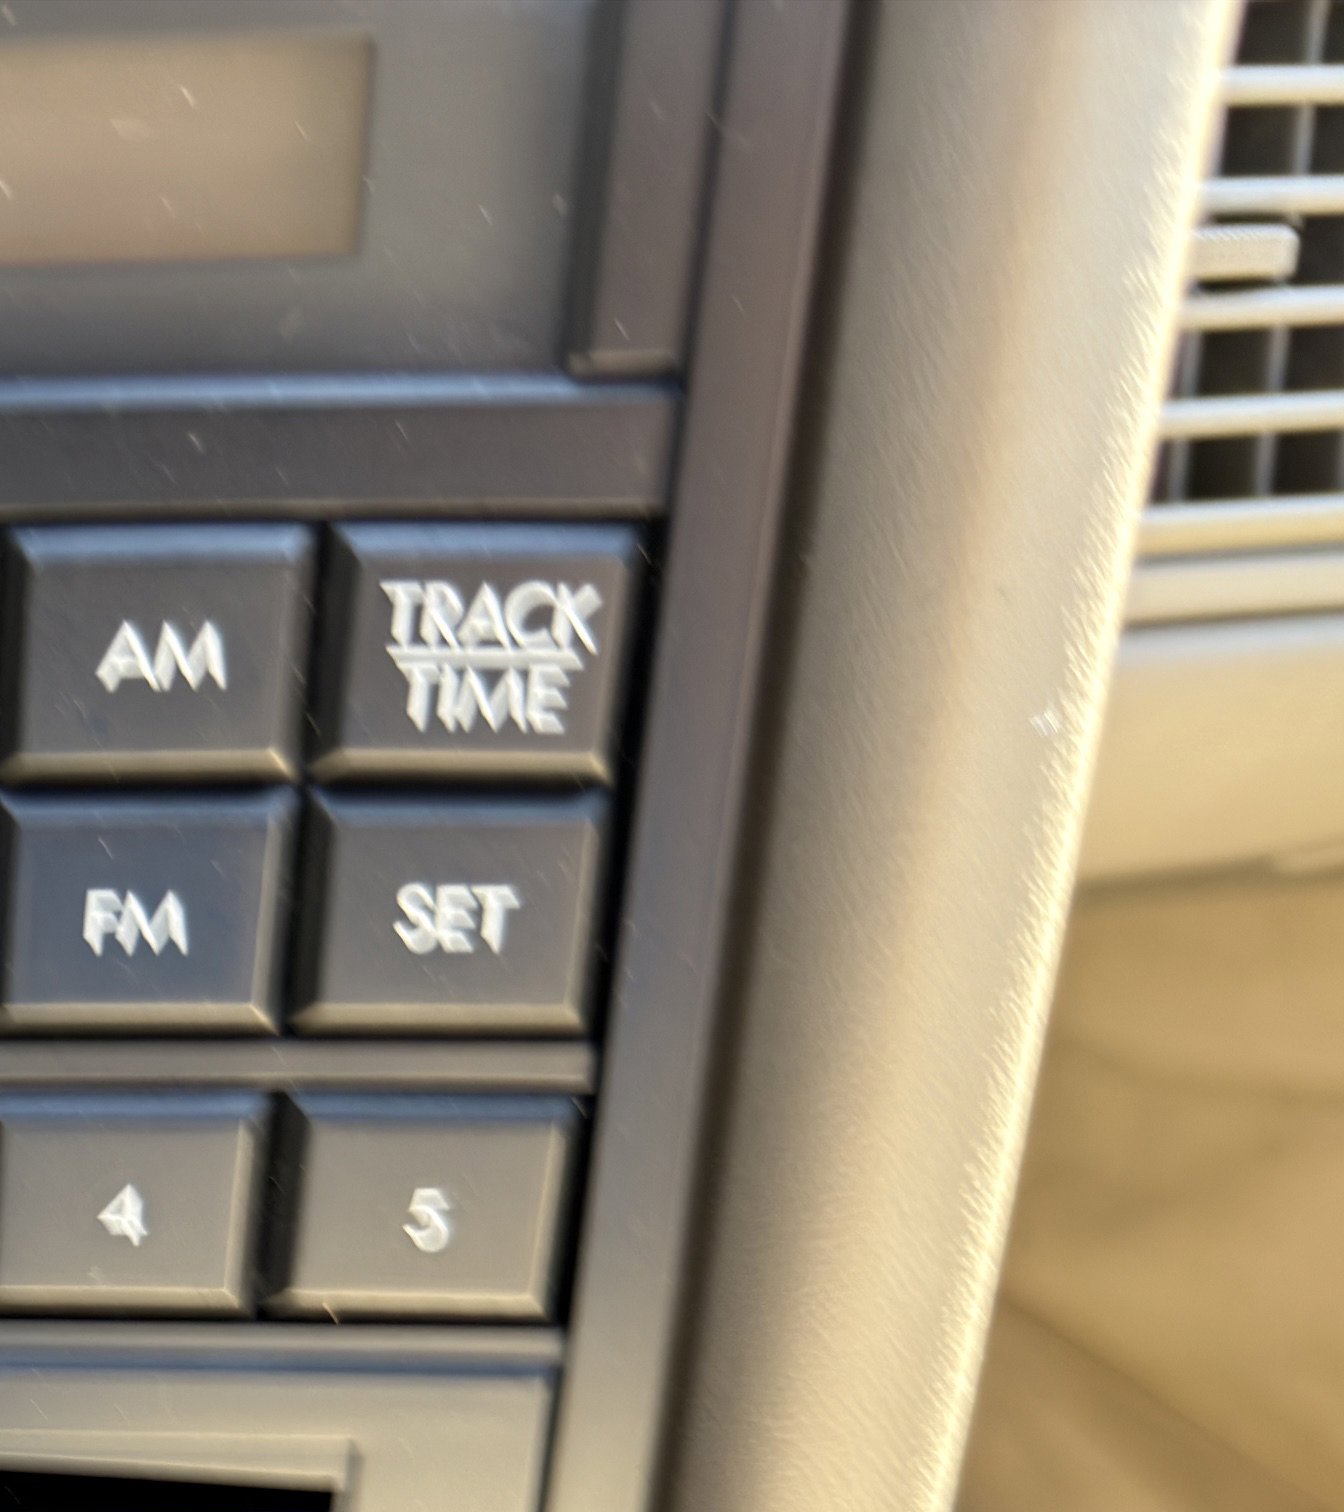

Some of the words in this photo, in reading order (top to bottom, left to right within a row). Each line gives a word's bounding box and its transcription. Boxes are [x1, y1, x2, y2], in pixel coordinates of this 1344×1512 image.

[380, 580, 602, 656] TRACK
[95, 619, 228, 692] AM
[395, 660, 572, 736] TIME
[82, 887, 190, 957] FM
[392, 883, 520, 955] SET
[97, 1183, 149, 1247] 4
[402, 1186, 452, 1254] 5
